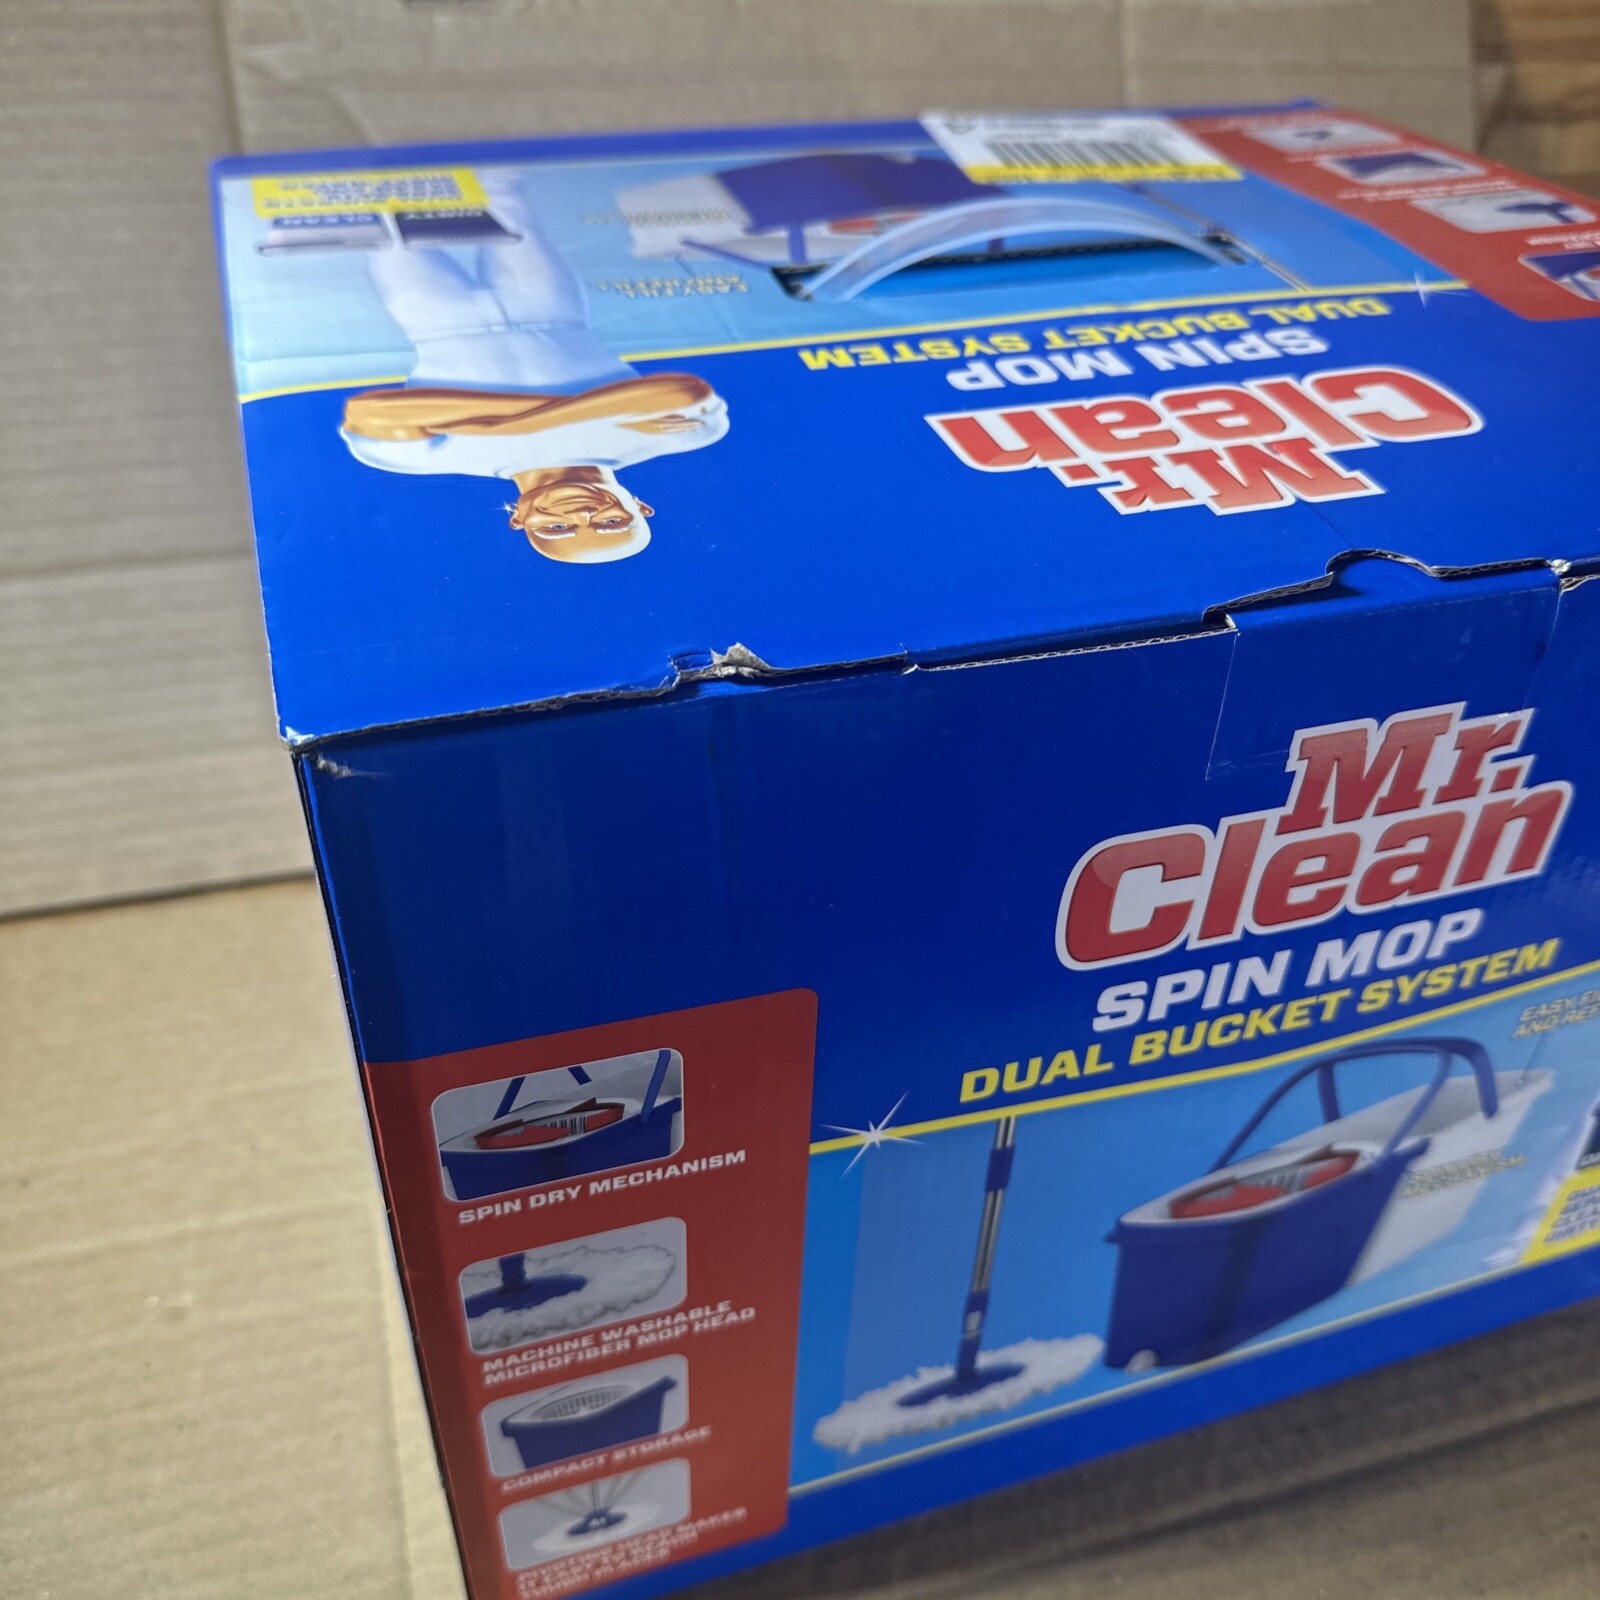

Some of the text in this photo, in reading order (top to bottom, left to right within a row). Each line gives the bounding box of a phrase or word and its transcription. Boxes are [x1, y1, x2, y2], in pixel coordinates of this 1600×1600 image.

[799, 297, 1391, 371] DUAL BUCKET SYSTEM
[946, 328, 1331, 391] SPIN MOP
[925, 366, 1484, 473] Clean
[1050, 436, 1386, 516] Mr.
[1276, 702, 1535, 837] Mr.
[1055, 781, 1574, 972] Clean
[1092, 907, 1484, 1033] SPIN MOP
[960, 937, 1561, 1106] DUAL BUCKET SYSTEM
[458, 1149, 747, 1225] SPIN DRY MECHANISM
[483, 1300, 733, 1373] MACHINE WASHABLE
[484, 1306, 757, 1386] MICROFIBER MOP HEAD
[501, 1424, 713, 1493] COMPACT STORAGE
